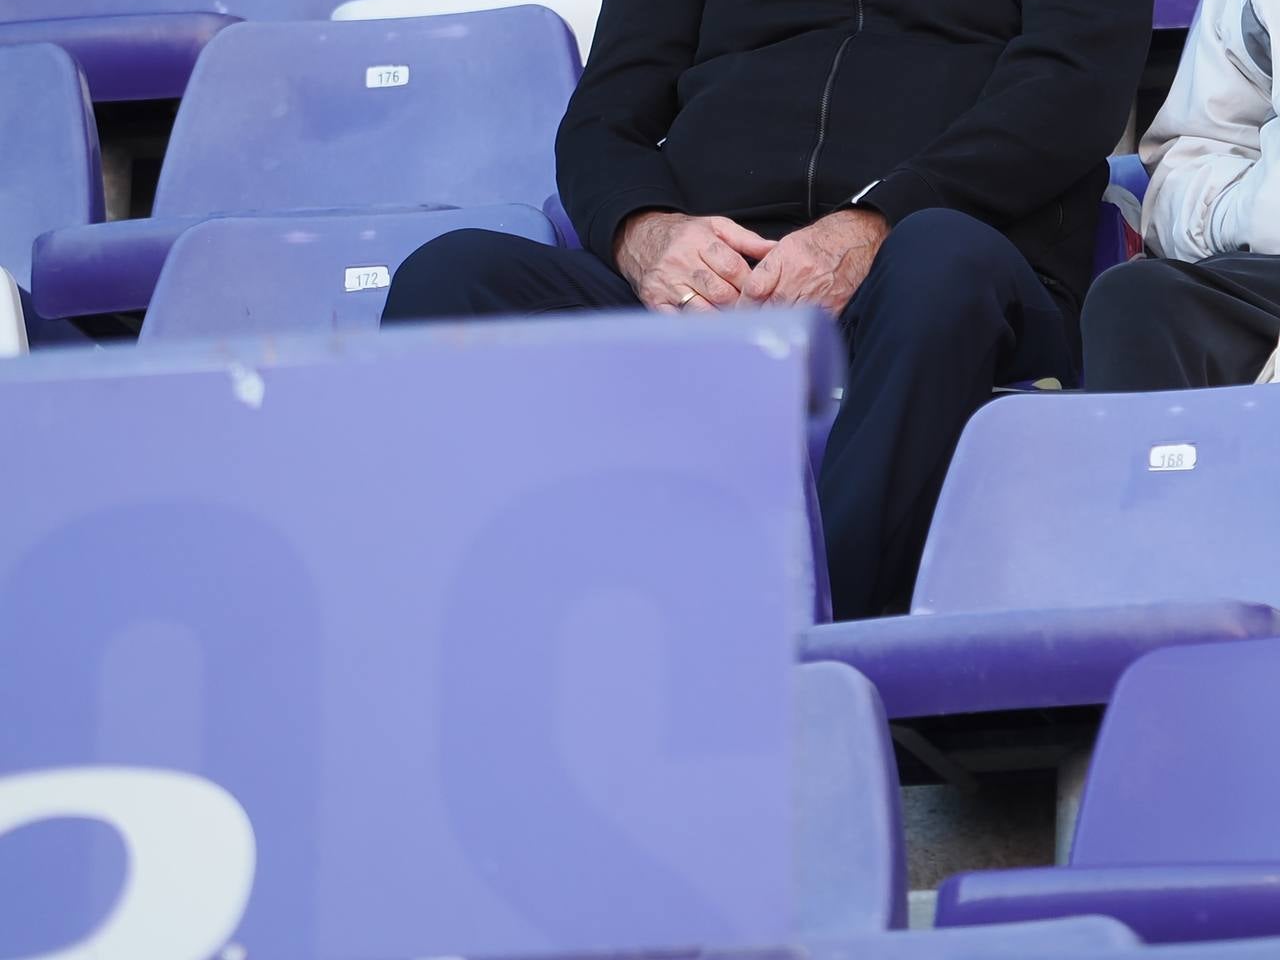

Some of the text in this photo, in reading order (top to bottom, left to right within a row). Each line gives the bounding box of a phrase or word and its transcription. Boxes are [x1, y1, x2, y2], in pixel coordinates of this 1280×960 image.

[377, 70, 400, 84] 176
[357, 272, 378, 286] 172
[1160, 453, 1184, 468] 168
